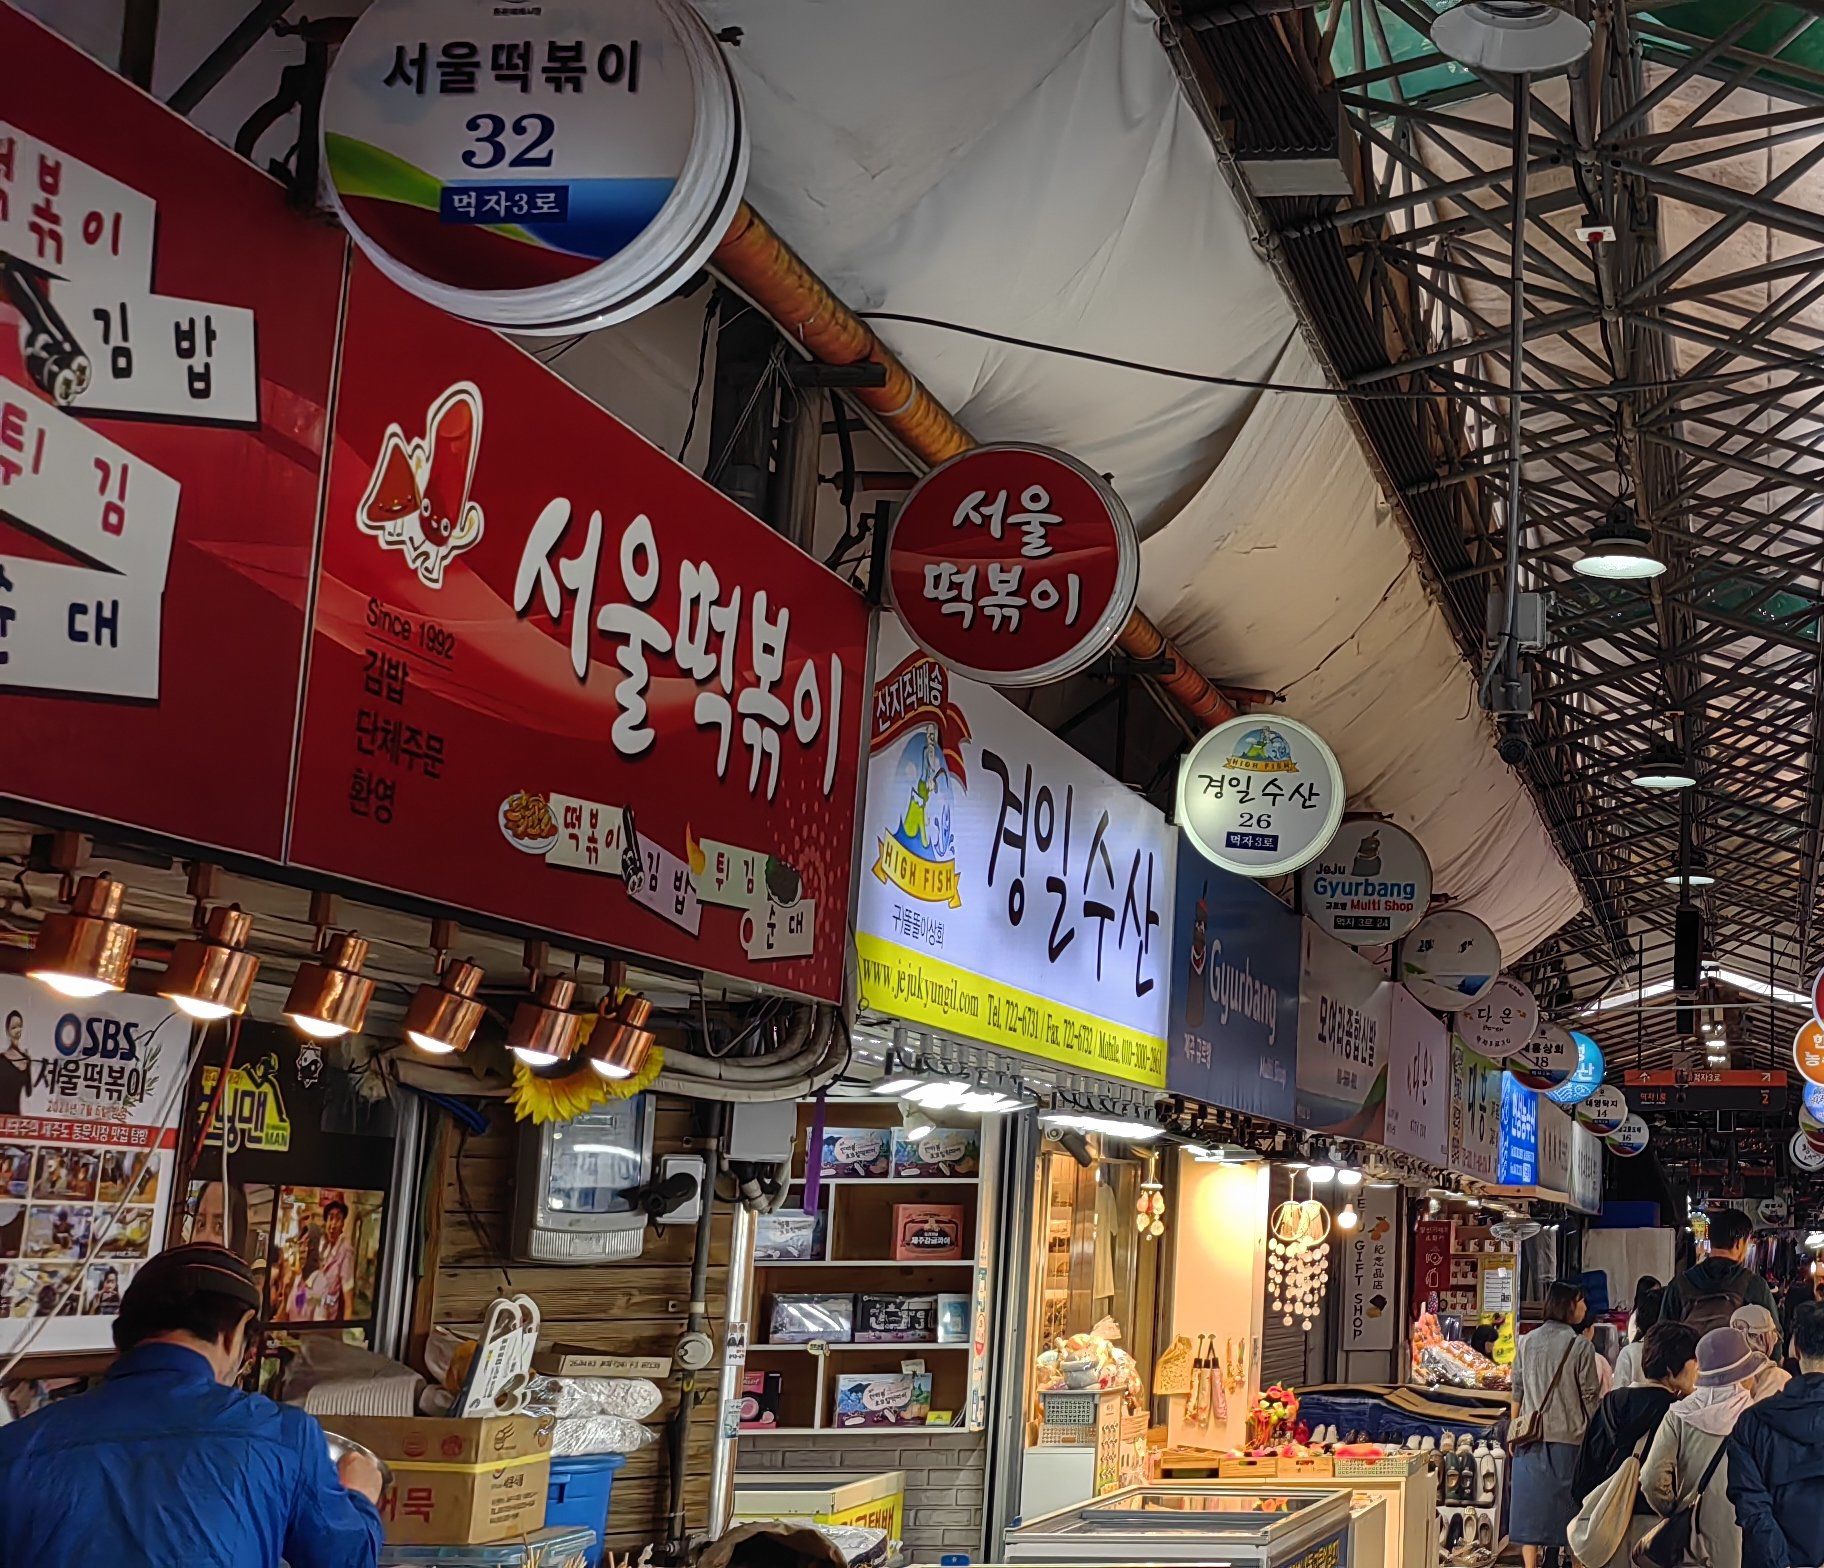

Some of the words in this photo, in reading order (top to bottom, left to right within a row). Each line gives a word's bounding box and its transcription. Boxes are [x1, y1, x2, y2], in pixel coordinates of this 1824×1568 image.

[384, 40, 642, 94] 서울떡볶이
[461, 113, 556, 169] 32
[452, 192, 560, 218] 먹자3로
[93, 302, 217, 399] 김밥
[952, 484, 1063, 558] 서울
[923, 561, 1084, 632] 떡볶이
[366, 596, 413, 641] Since
[418, 621, 455, 660] 1992
[513, 497, 844, 798] 서울떡볶이
[364, 649, 409, 705] 김밥
[877, 661, 944, 731] 산지직배송
[356, 708, 444, 780] 단체주문
[349, 768, 396, 825] 환영
[1198, 775, 1321, 810] 경일수산
[564, 804, 621, 865] 떡볶이
[1230, 834, 1274, 848] 먹자3로
[1238, 812, 1272, 829] 26
[647, 851, 697, 916] 김밥
[715, 852, 754, 894] 튀김
[882, 843, 917, 885] HIGH
[922, 862, 956, 893] FISH
[982, 749, 1160, 998] 경일수산
[1313, 877, 1415, 900] Gyurbang
[1315, 863, 1346, 876] JeJu
[766, 905, 804, 950] 순대
[1350, 901, 1381, 912] Multi
[1384, 901, 1414, 913] Shop
[1209, 939, 1277, 1046] Gyurbang
[82, 1017, 139, 1060] SBS
[1005, 1000, 1039, 1040] 722-6731
[72, 1122, 110, 1142] 동문시장
[111, 1125, 130, 1143] 맛집
[130, 1128, 149, 1145] 탐방
[1595, 1109, 1607, 1118] 14
[1354, 1240, 1366, 1287] GIFT
[1352, 1293, 1364, 1341] SHOP
